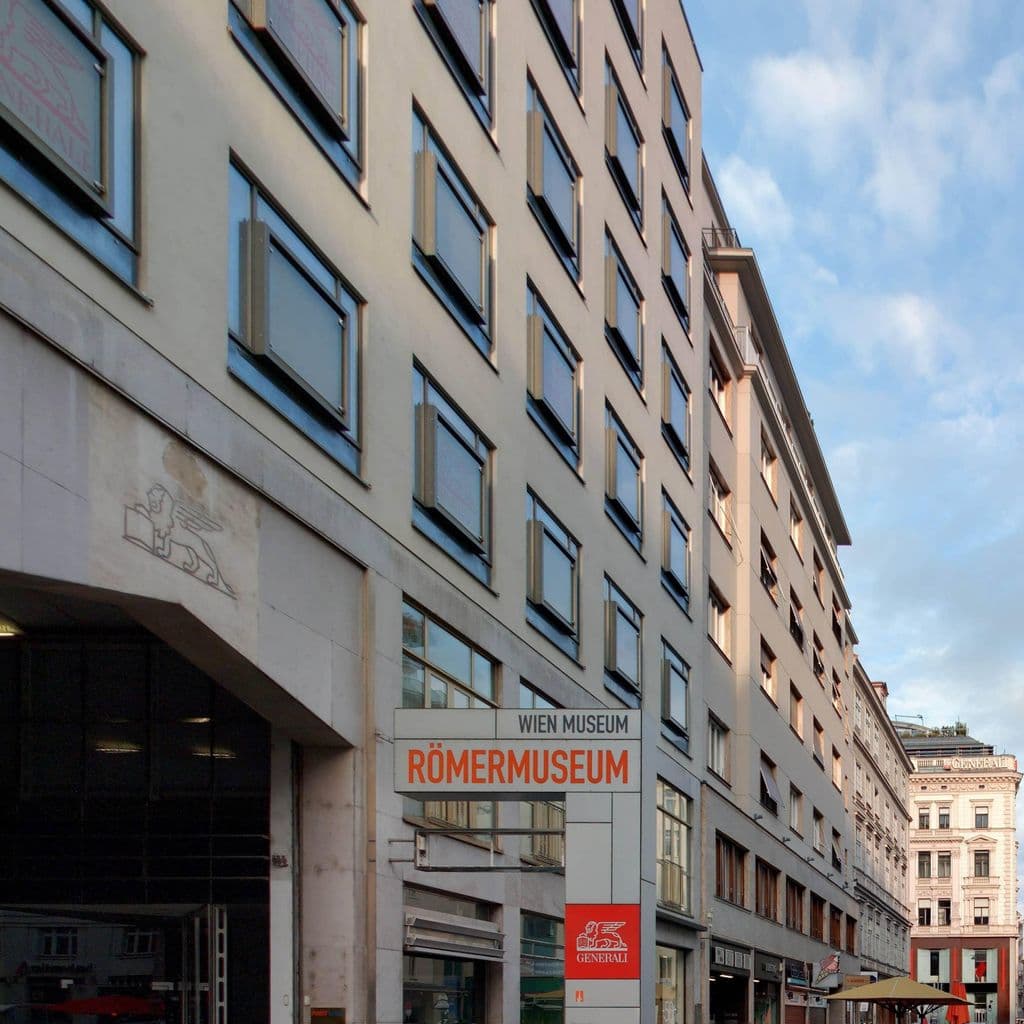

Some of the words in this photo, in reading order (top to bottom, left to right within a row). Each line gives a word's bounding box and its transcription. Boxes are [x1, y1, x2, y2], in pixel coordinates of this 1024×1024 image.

[518, 714, 557, 733] WIEN
[562, 714, 629, 733] MUSEUM
[407, 742, 629, 785] RÖMERMUSEUM
[576, 953, 629, 963] GENERALI
